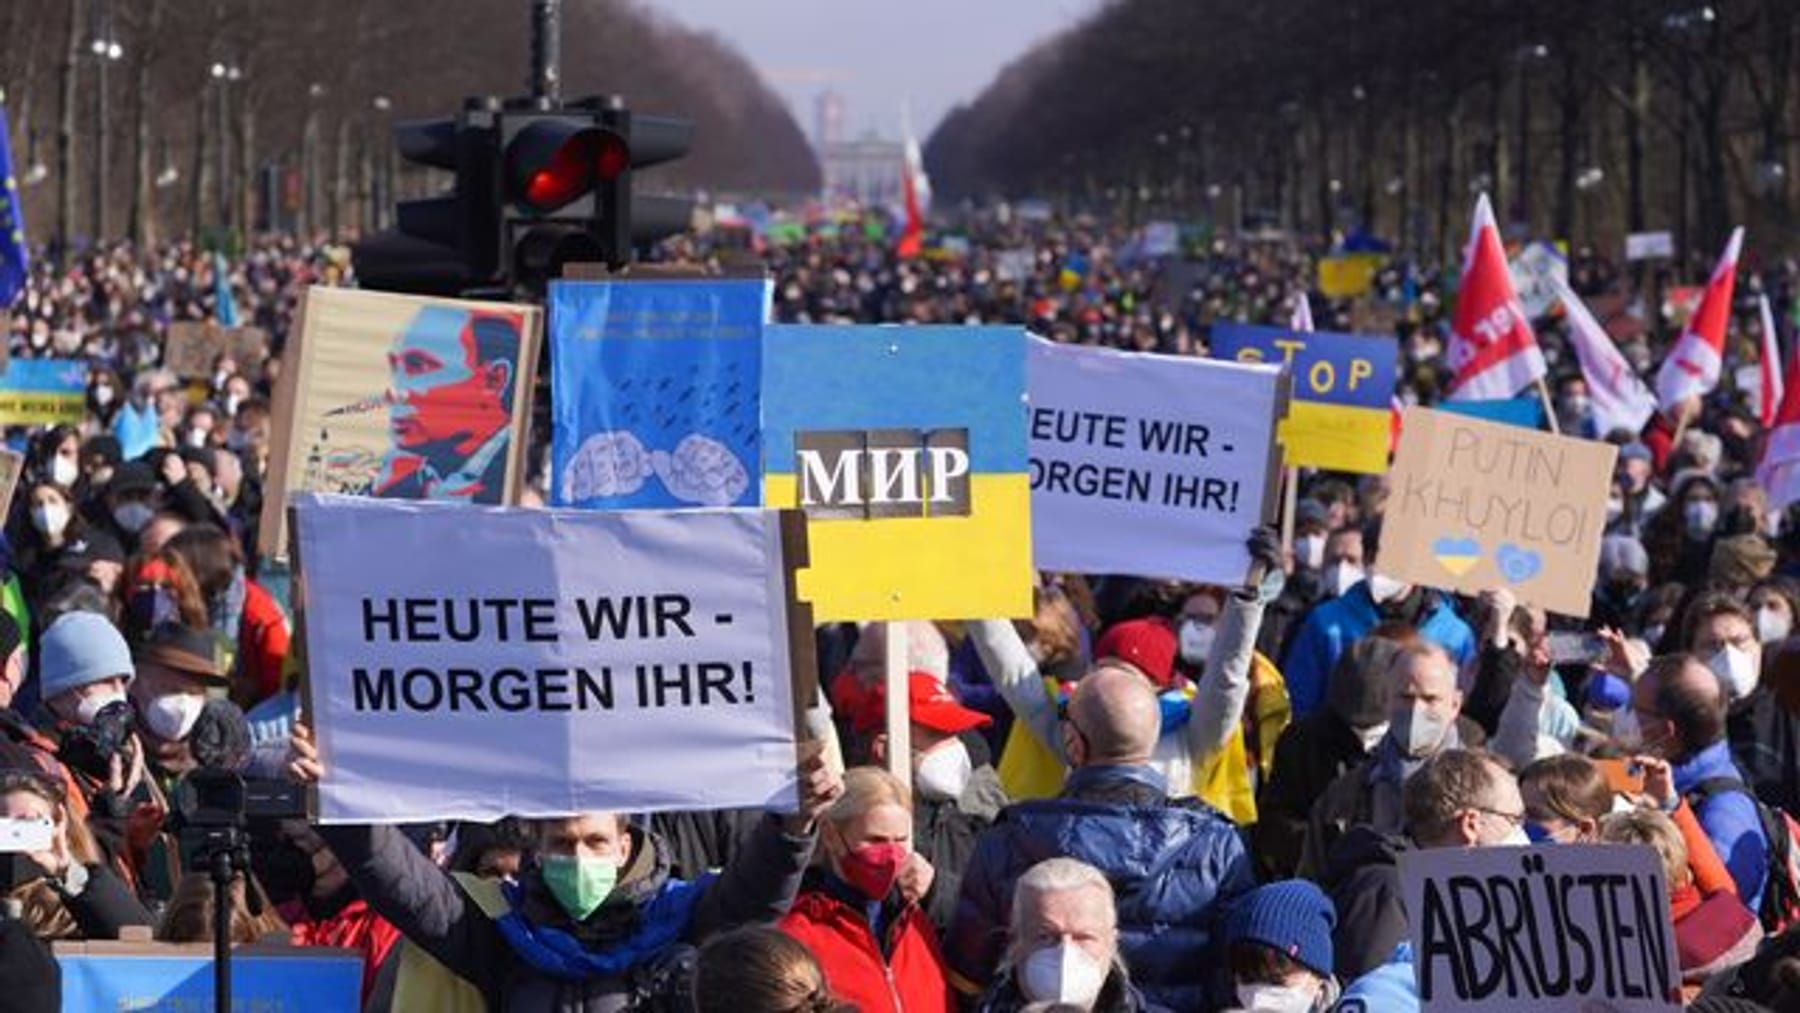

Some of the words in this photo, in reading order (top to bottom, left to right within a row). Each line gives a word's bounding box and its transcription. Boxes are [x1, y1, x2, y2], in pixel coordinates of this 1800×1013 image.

[1027, 407, 1127, 449] EUTE
[1139, 418, 1209, 458] WIR
[1449, 427, 1565, 487] PUTIN
[797, 447, 970, 505] МИР
[1029, 457, 1151, 503] ORGEN
[1161, 472, 1240, 514] IHR!
[362, 597, 560, 643] HEUTE
[577, 594, 697, 641] WIR
[351, 666, 615, 712] MORGEN
[636, 660, 756, 708] IHR!
[1420, 853, 1671, 1003] ABRÜSTEN
